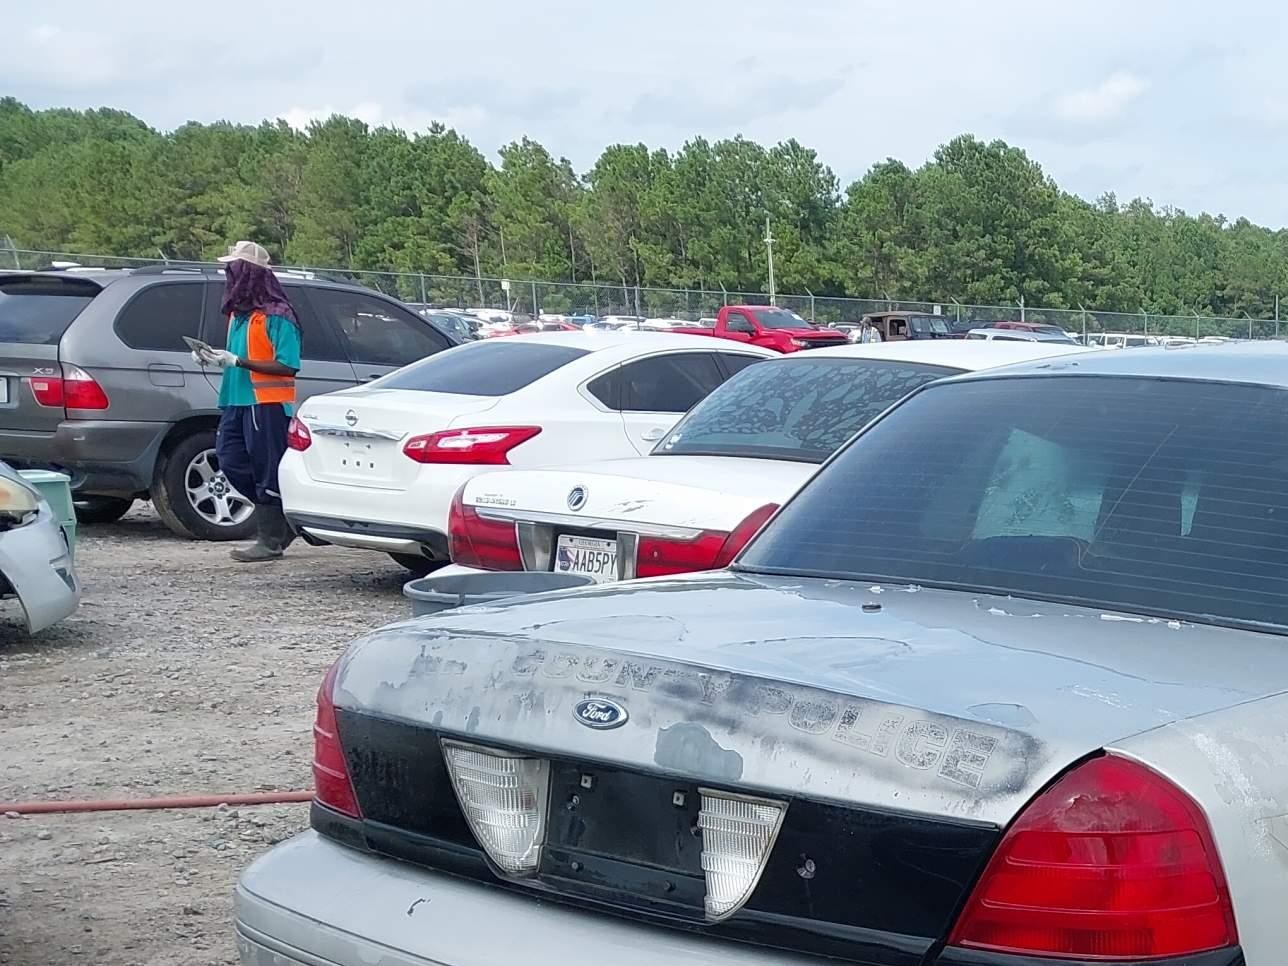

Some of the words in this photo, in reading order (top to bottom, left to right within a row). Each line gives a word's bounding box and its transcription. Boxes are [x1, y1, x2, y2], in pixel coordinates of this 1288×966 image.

[572, 550, 617, 575] AAB5PY
[581, 702, 613, 721] Ford
[745, 684, 1001, 791] POLICE
